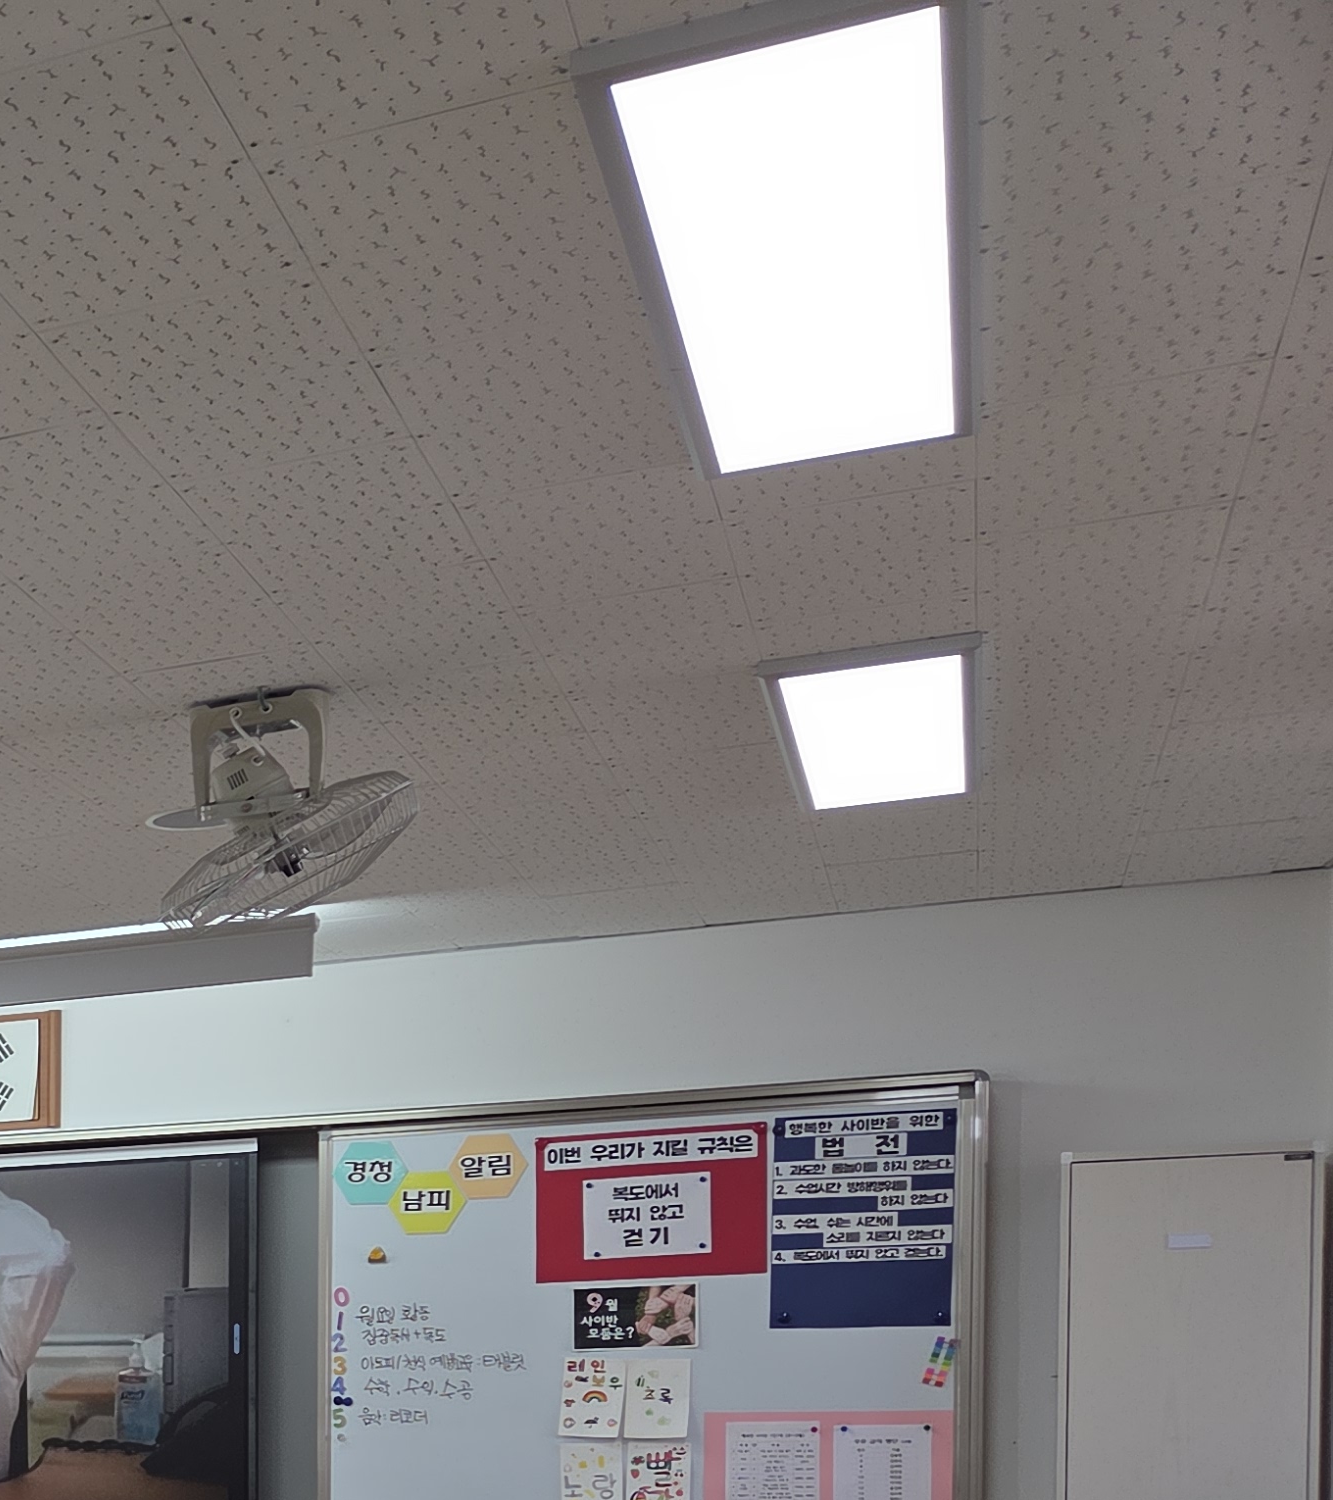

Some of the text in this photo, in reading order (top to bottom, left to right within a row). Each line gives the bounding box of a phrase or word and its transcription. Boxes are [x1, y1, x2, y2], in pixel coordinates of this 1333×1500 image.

[789, 1120, 833, 1136] 행복한
[909, 1114, 940, 1127] 위한
[547, 1134, 754, 1164] 이번 우리가 지킬 규칙은
[344, 1160, 393, 1184] 경청
[459, 1154, 512, 1179] 알림
[882, 1160, 907, 1172] 하지
[402, 1189, 451, 1212] 남피
[612, 1182, 679, 1202] 복도에서
[880, 1194, 905, 1207] 하지
[608, 1204, 685, 1223] 뛰지 않고
[856, 1215, 894, 1227] 시간에
[333, 1286, 351, 1308] 0
[354, 1304, 396, 1327] 월요일
[580, 1314, 619, 1328] 사이반
[330, 1332, 348, 1354] 2
[333, 1355, 348, 1376] 3
[331, 1376, 346, 1396] 4
[333, 1407, 348, 1429] 5
